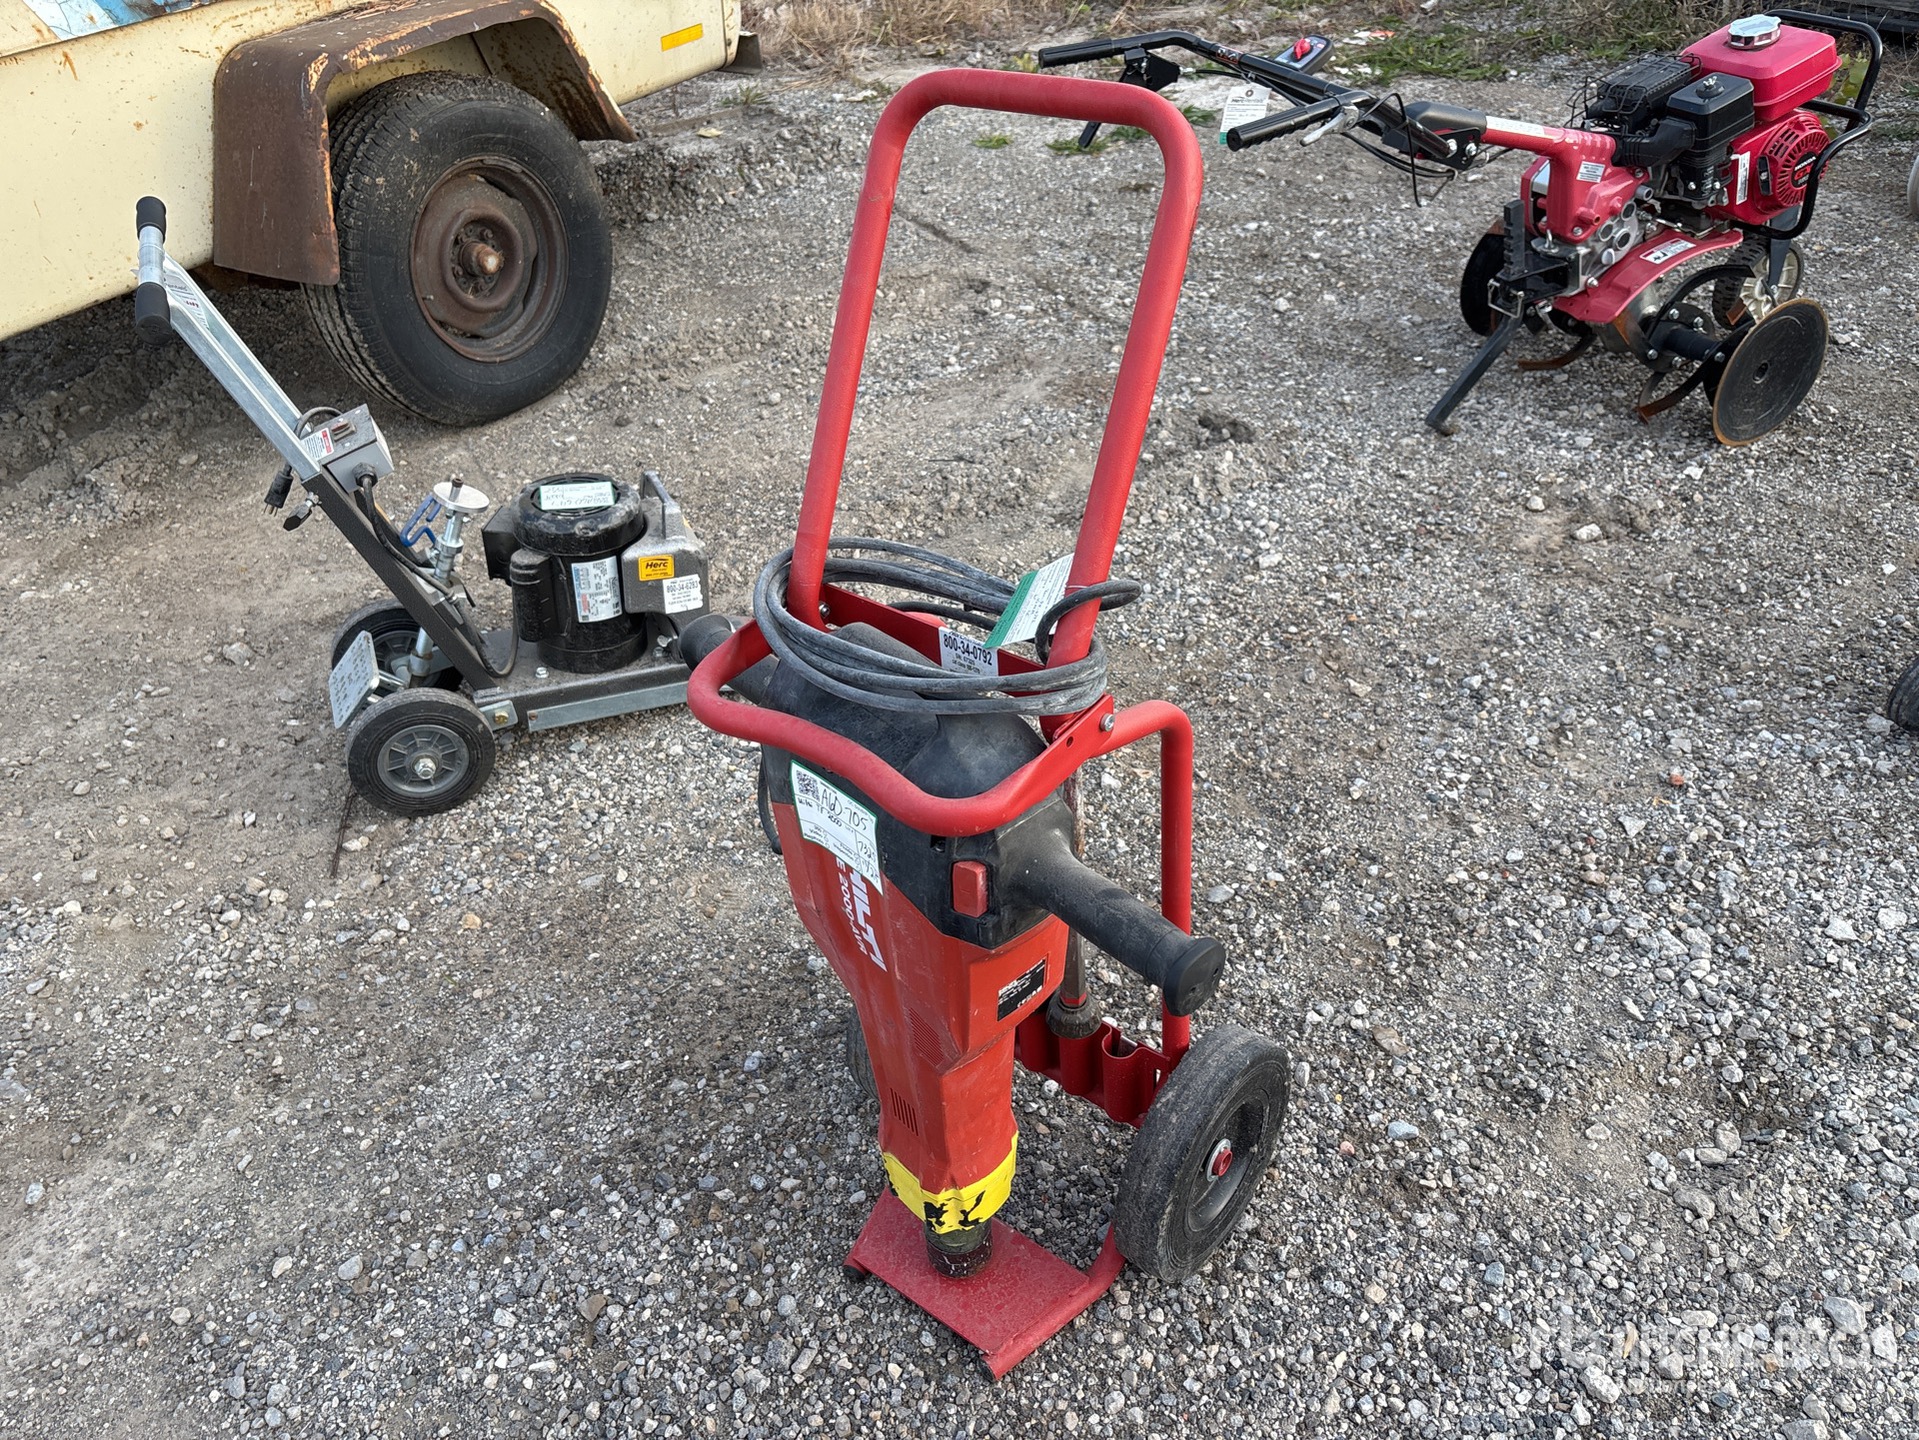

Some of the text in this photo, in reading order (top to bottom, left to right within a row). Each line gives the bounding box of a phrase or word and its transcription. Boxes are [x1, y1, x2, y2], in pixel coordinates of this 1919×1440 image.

[1794, 156, 1817, 171] HONDA
[645, 561, 669, 569] Herc
[943, 633, 993, 666] 800-34-0792
